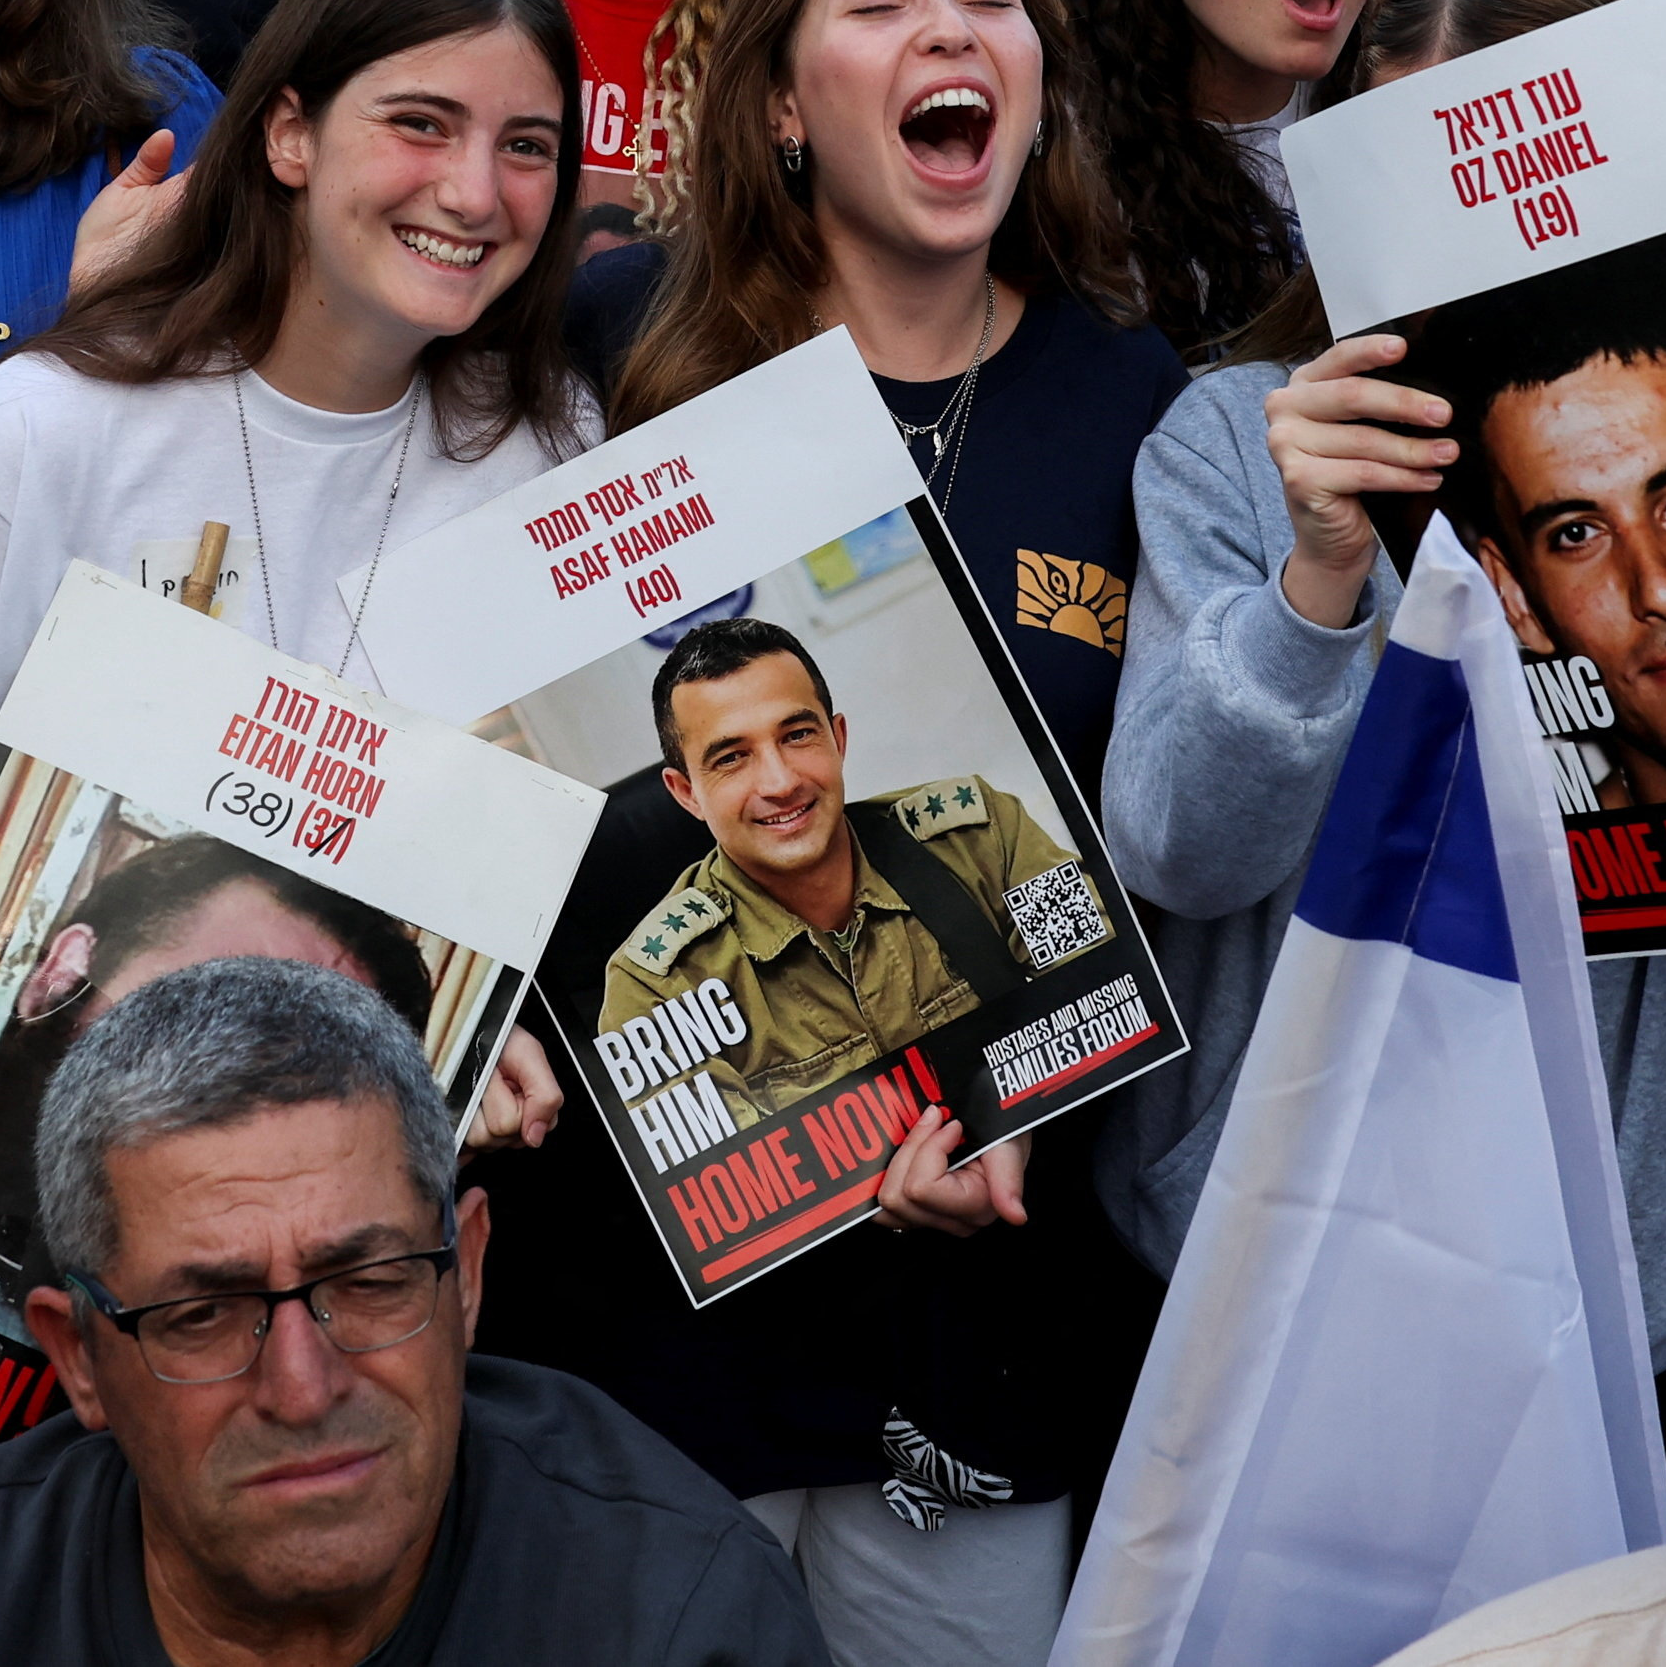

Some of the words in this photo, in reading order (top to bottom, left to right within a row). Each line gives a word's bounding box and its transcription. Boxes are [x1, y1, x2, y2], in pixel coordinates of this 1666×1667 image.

[1433, 88, 1515, 156] דניאל
[1522, 68, 1584, 115] עוז
[1450, 152, 1497, 209] OZ
[1493, 122, 1609, 192] DANIEL
[1515, 186, 1579, 251] (19)
[524, 499, 589, 553] חממי
[586, 472, 640, 524] אסף
[550, 545, 614, 603] ASAF
[609, 493, 716, 567] HAMAMI
[624, 563, 684, 619] (40)
[254, 676, 318, 728] הורן
[1532, 654, 1613, 734] ING
[218, 712, 302, 778] EITAN
[299, 755, 386, 819] HORN
[324, 705, 388, 761] איתן
[204, 770, 294, 839] (38)
[592, 978, 749, 1101] BRING
[982, 1015, 1055, 1071] HOSTAGES
[1048, 1001, 1082, 1036] AND
[1074, 973, 1138, 1020] MISSING
[994, 1038, 1082, 1103] FAMILIES
[1078, 999, 1154, 1057] FORUM
[626, 1071, 737, 1176] HIM
[666, 1135, 818, 1255] HOME
[819, 1045, 953, 1171] NOW!
